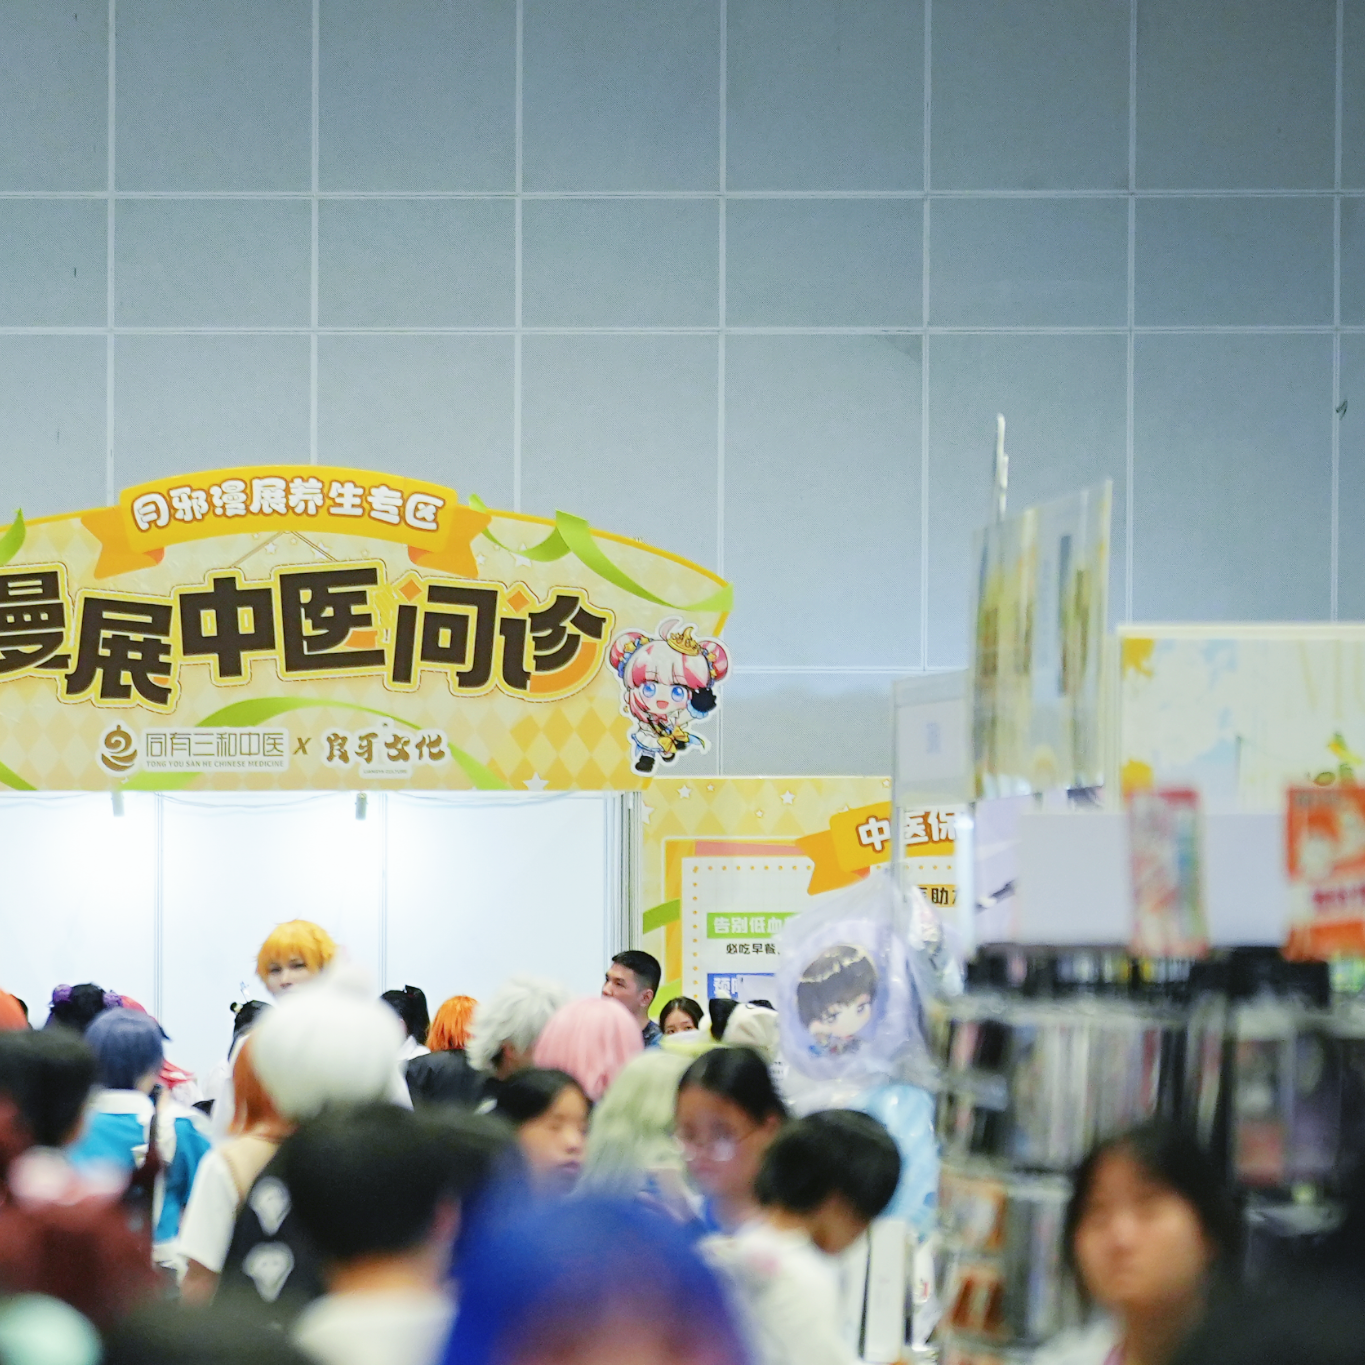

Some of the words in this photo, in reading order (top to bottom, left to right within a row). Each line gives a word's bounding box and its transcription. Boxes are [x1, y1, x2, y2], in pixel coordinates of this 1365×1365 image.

[133, 477, 444, 530] 月邪漫展养生专区
[146, 732, 284, 757] 同有三和中医
[146, 760, 167, 768] TONG
[168, 760, 184, 768] YOU
[185, 760, 201, 768] SAN
[203, 760, 212, 768] HE
[214, 760, 246, 768] CHINESE
[247, 760, 284, 768] MEDICINE
[714, 916, 791, 934] 告别低血
